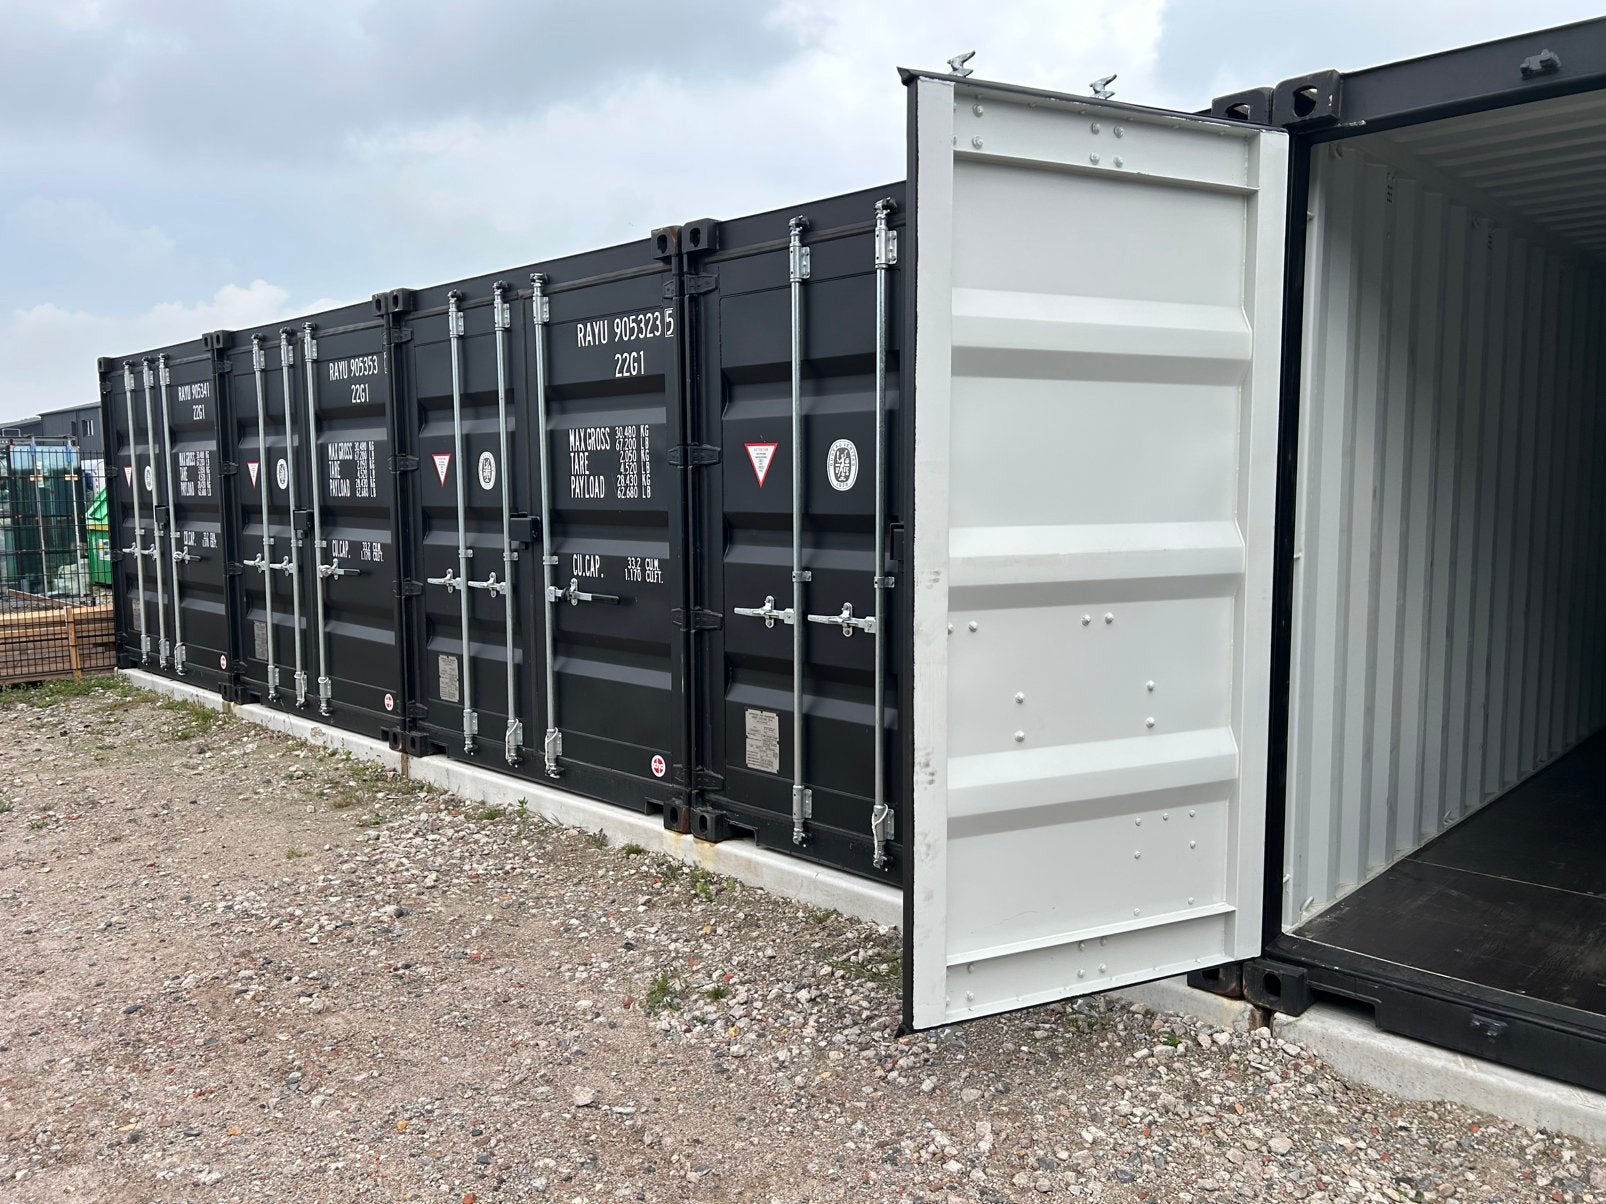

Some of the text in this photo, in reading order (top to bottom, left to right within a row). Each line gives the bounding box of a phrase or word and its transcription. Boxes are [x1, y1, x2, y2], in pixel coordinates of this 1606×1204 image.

[577, 320, 608, 347] RAYU
[614, 312, 662, 342] 905323
[329, 361, 348, 380] RAYU
[350, 355, 378, 376] 905353
[615, 350, 645, 377] 22G1
[351, 383, 369, 403] 22G1
[569, 429, 586, 451] MAX
[586, 427, 611, 451] GROSS
[640, 424, 649, 437] KG
[640, 437, 649, 449] LB
[570, 452, 590, 475] TARE
[641, 449, 650, 462] KG
[641, 461, 651, 473] LB
[571, 476, 605, 498] PAYLOAD
[642, 473, 651, 486] KG
[642, 486, 651, 498] LB
[572, 554, 604, 578] CU.CAP.
